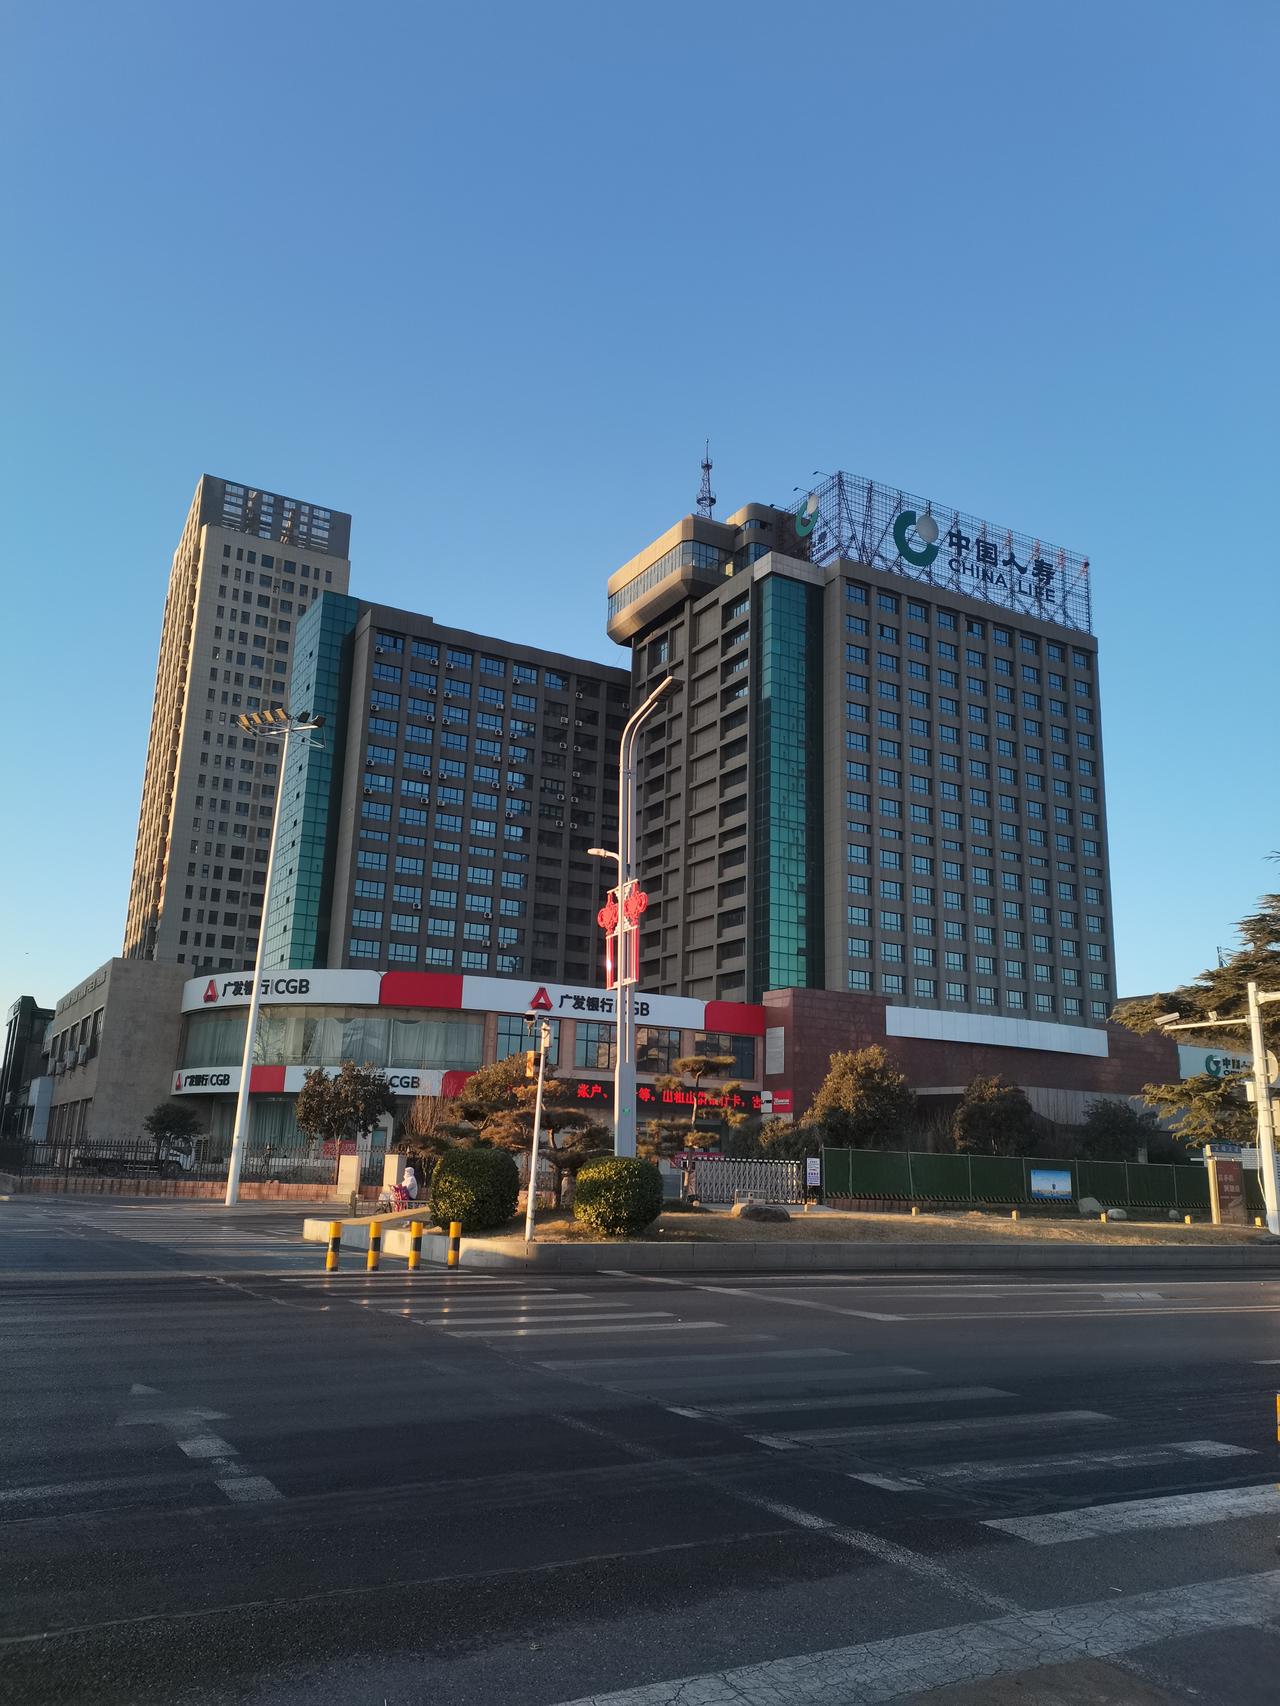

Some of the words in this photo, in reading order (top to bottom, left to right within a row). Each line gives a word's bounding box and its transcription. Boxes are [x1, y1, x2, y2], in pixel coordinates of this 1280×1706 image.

[948, 530, 1056, 586] 中国人寿
[948, 558, 1008, 588] CHINA
[1018, 579, 1056, 603] LIFE
[275, 979, 310, 994] CGB
[559, 994, 613, 1012] 广发银行
[210, 1073, 231, 1086] CGB
[389, 1075, 420, 1089] CGB
